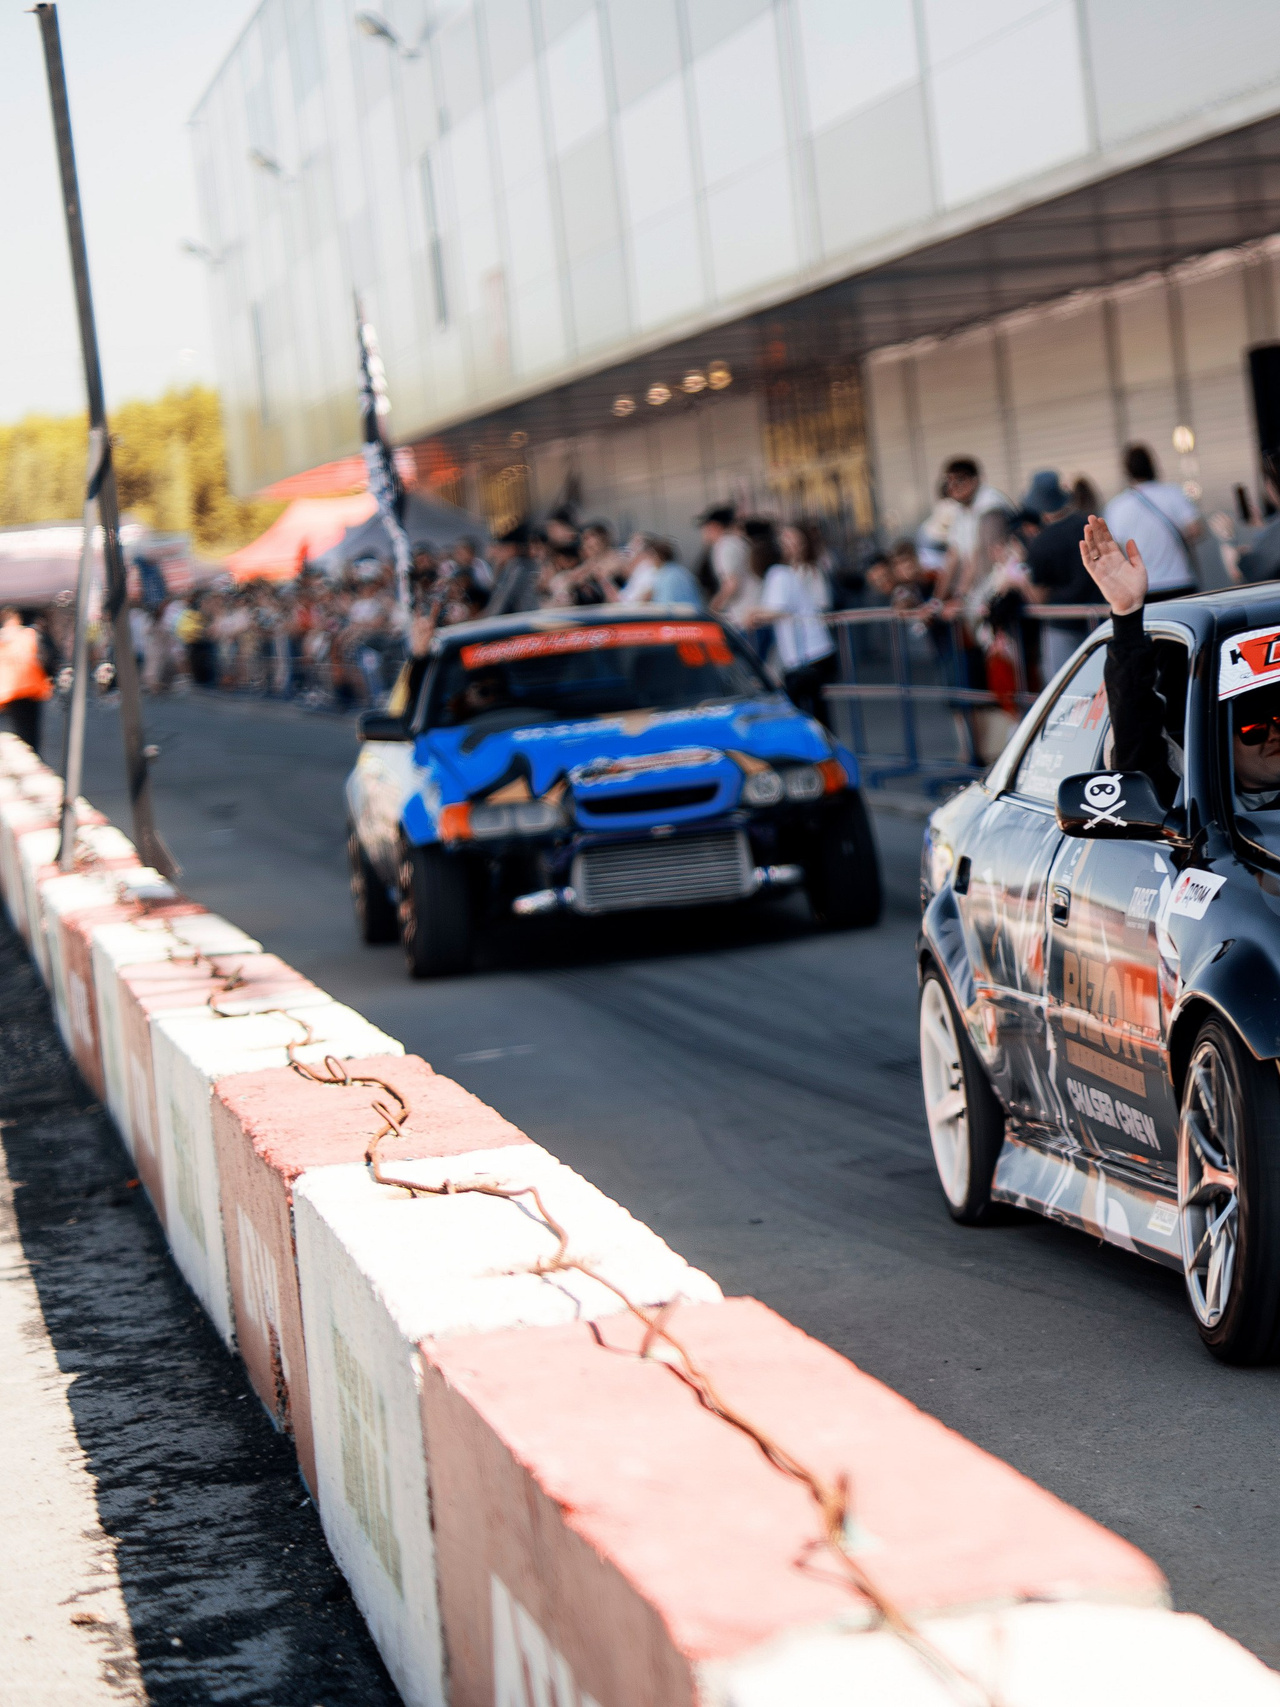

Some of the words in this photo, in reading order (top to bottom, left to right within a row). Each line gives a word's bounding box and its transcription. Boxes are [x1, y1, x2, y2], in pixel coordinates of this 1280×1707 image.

[1063, 950, 1145, 1065] BIZON
[1066, 1077, 1121, 1131] CHASER
[1115, 1099, 1162, 1151] CREW
